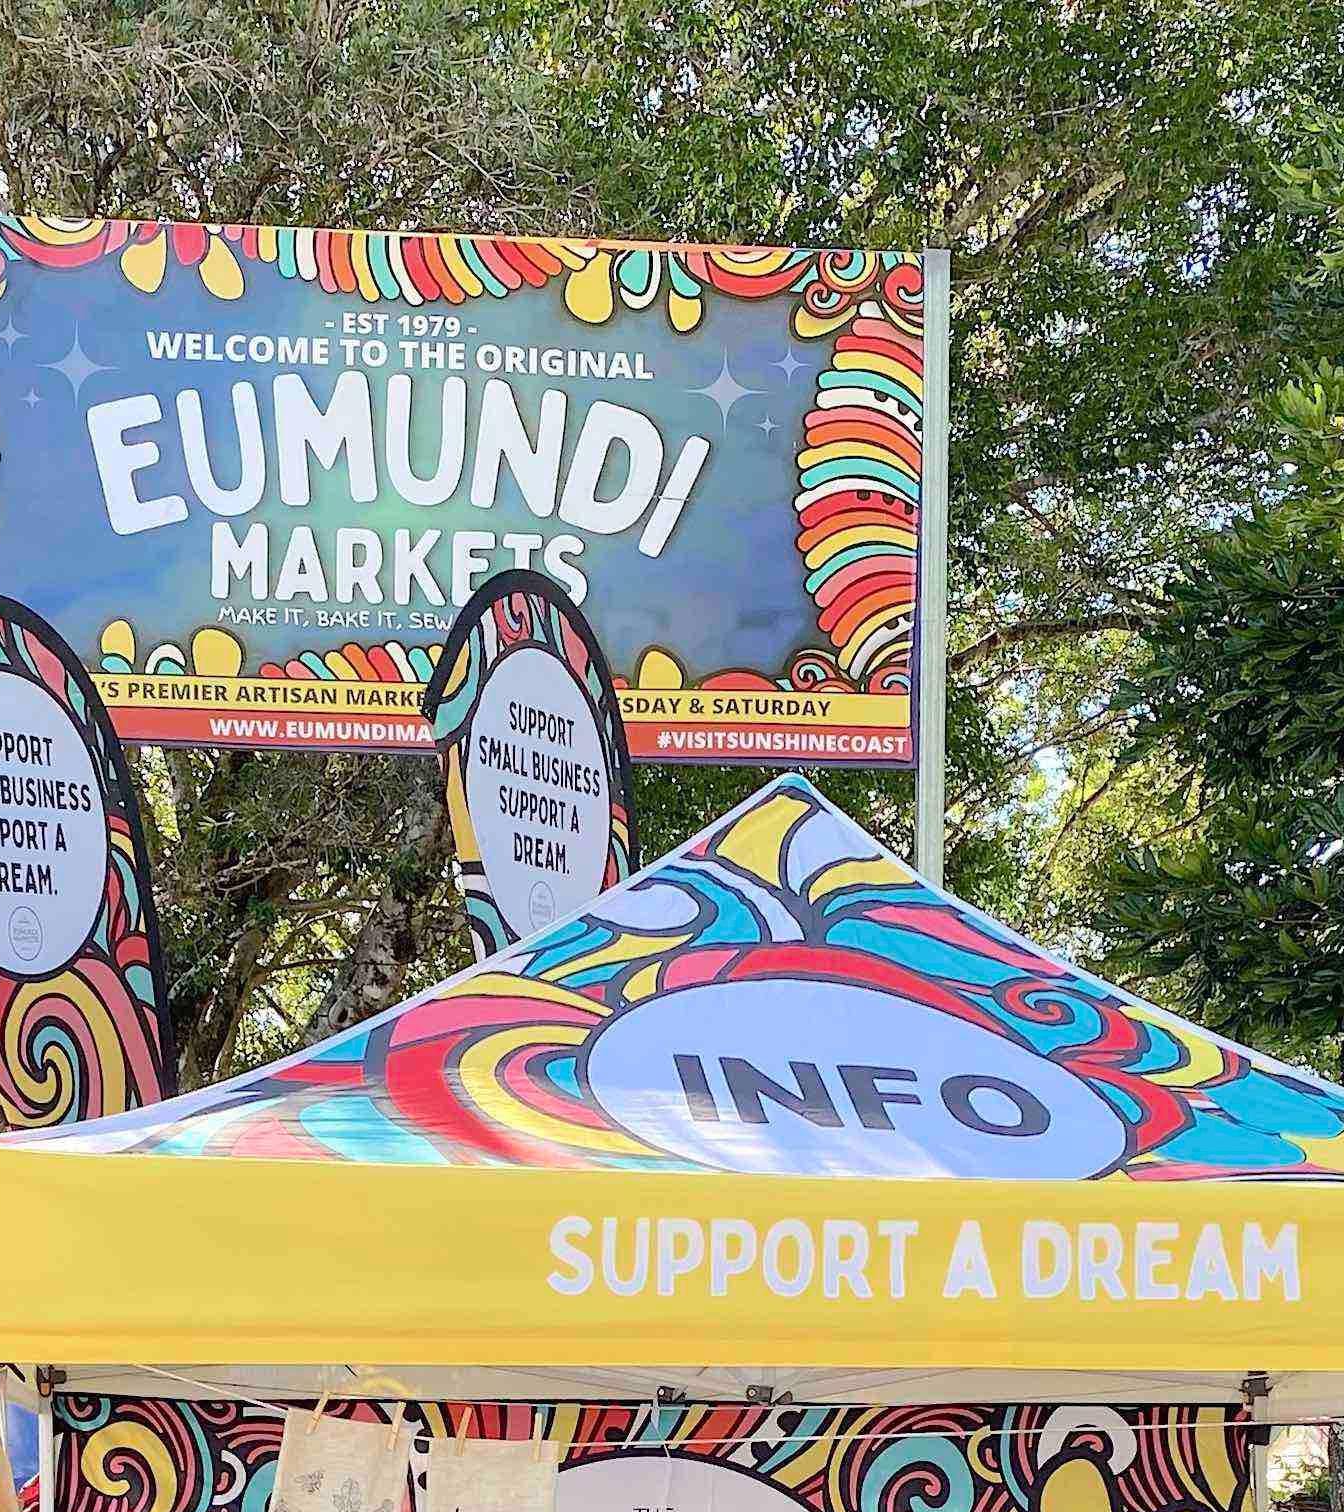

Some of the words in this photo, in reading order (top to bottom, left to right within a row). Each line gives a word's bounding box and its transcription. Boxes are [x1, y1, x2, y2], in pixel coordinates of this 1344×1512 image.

[342, 312, 389, 337] EST
[398, 314, 461, 338] 1979
[146, 332, 329, 366] WELCOME
[339, 339, 389, 368] TO
[398, 341, 466, 370] THE
[476, 343, 655, 380] ORIGINAL
[85, 370, 711, 559] EUMUNDI
[211, 521, 589, 607] MARKETS
[217, 606, 277, 624] MAKE
[315, 610, 370, 629] BAKE
[128, 682, 229, 702] PREMIER
[236, 685, 338, 706] ARTISAN
[346, 689, 427, 708] MARKE
[622, 697, 682, 715] SDAY
[689, 698, 705, 714] &
[712, 699, 831, 718] SATURDAY
[209, 718, 434, 743] WWW.EUMUNDIMA
[509, 701, 575, 748] SUPPORT
[656, 730, 908, 755] #VISITSUNSHINECOAST
[479, 735, 529, 778] SMALL
[532, 750, 601, 797] BUSINESS
[0, 775, 91, 812] BUSINESS
[499, 784, 566, 829] SUPPORT
[570, 807, 581, 834] A
[55, 823, 67, 852] A
[513, 832, 570, 876] DREAM.
[672, 1054, 1051, 1137] INFO
[546, 1215, 920, 1299] SUPPORT
[942, 1218, 998, 1299] A
[1020, 1218, 1301, 1301] DREAM
